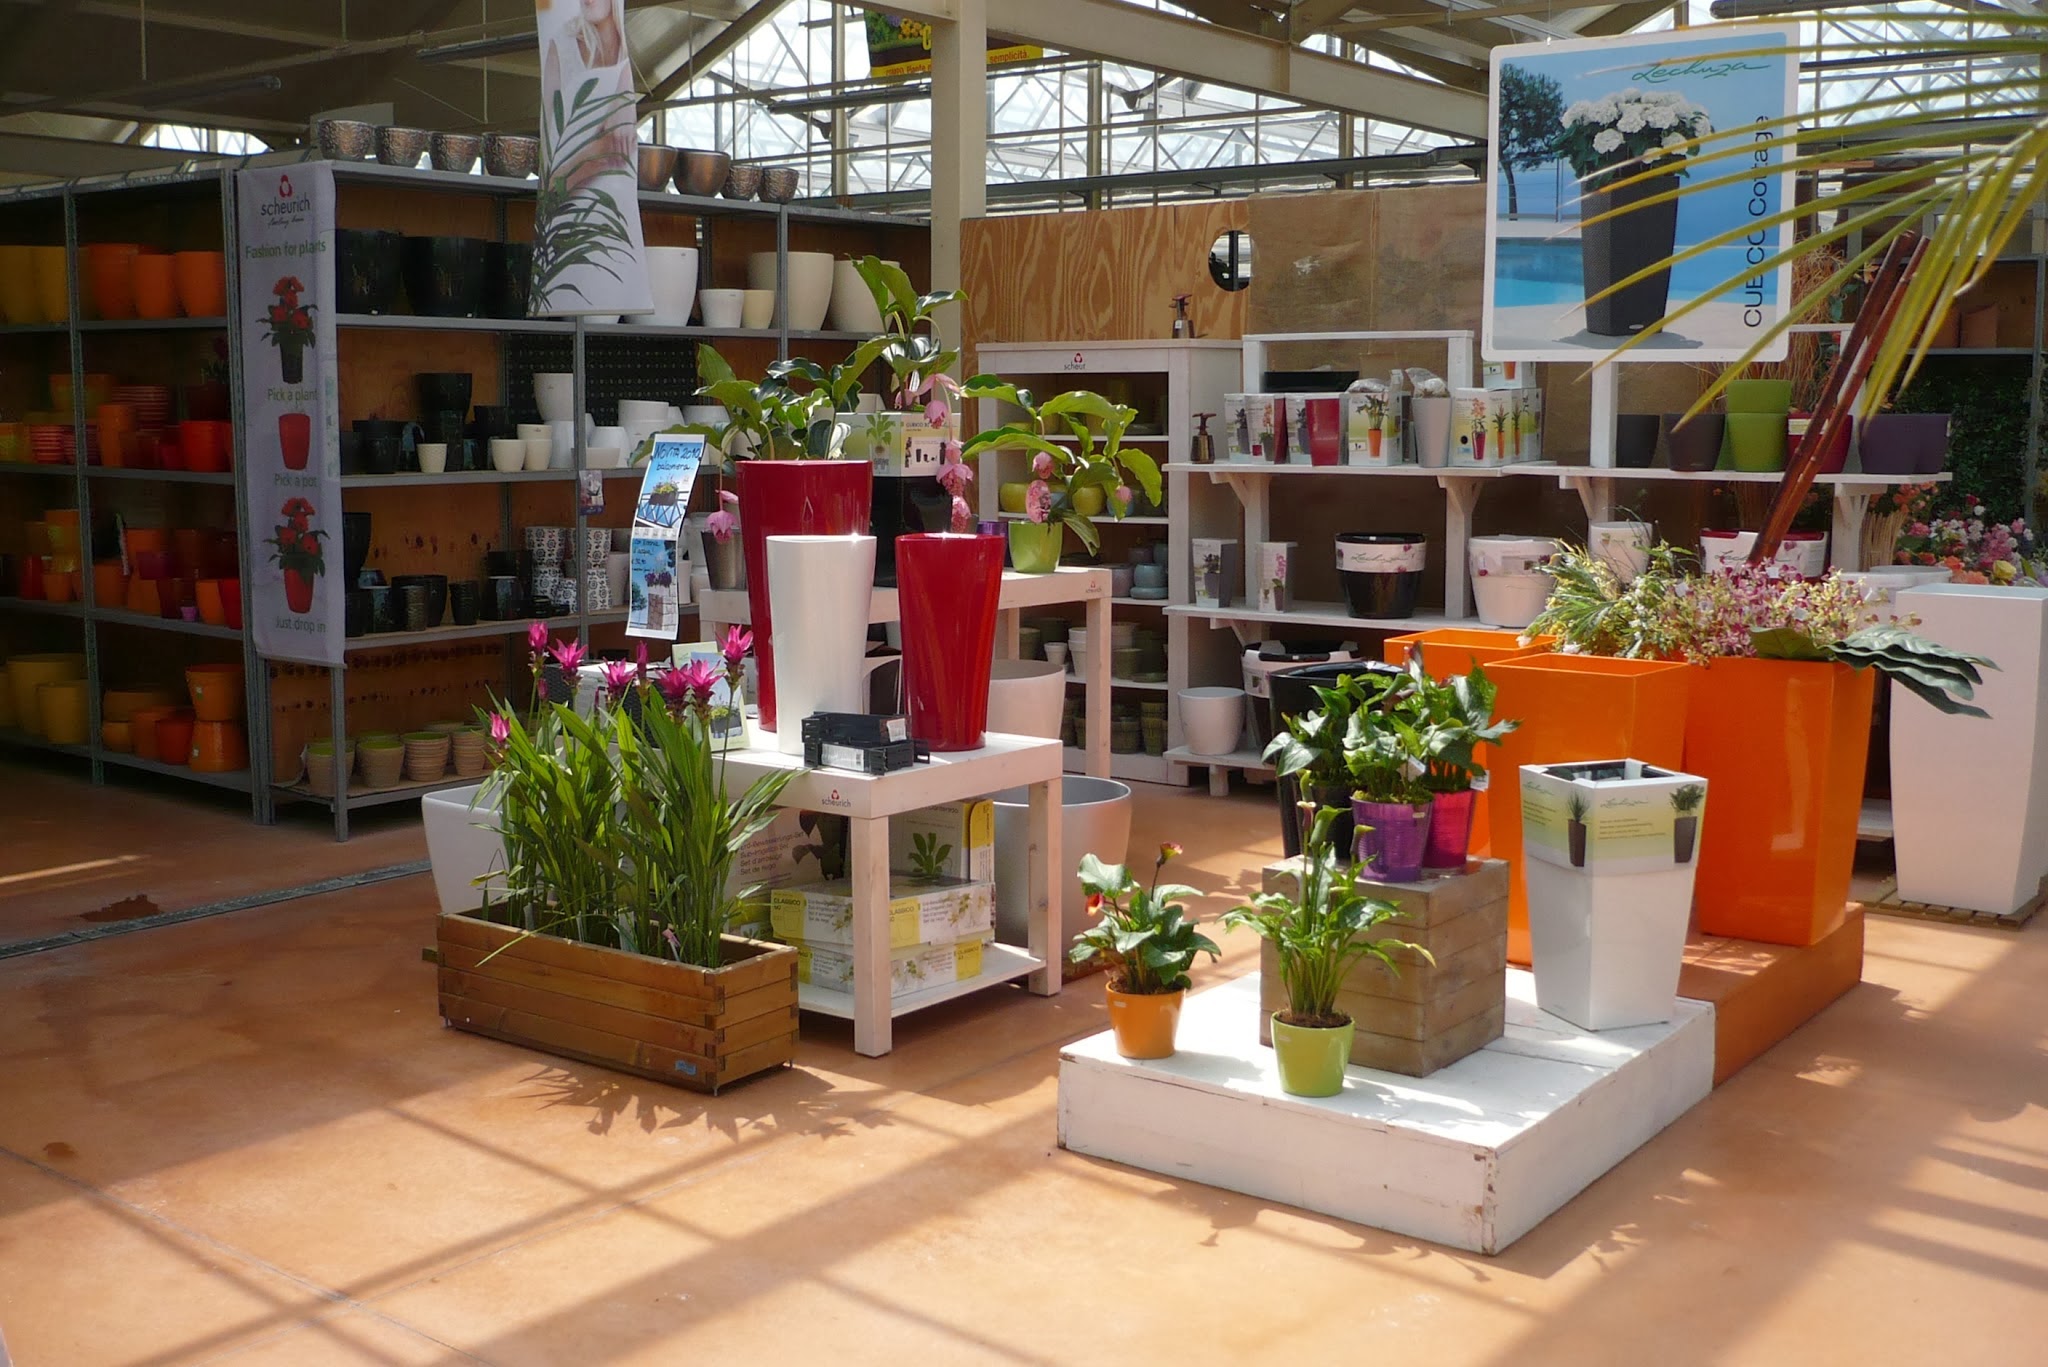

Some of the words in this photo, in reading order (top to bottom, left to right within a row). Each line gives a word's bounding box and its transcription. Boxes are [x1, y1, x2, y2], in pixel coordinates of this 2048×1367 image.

[1631, 57, 1771, 84] Lechuza
[261, 192, 310, 216] scheurich
[245, 245, 281, 259] Fashion
[267, 388, 286, 401] Pick
[287, 391, 293, 401] a
[295, 388, 319, 408] plant
[274, 474, 291, 486] Pick
[275, 616, 292, 629] Just
[294, 618, 315, 634] drop
[317, 620, 326, 633] in
